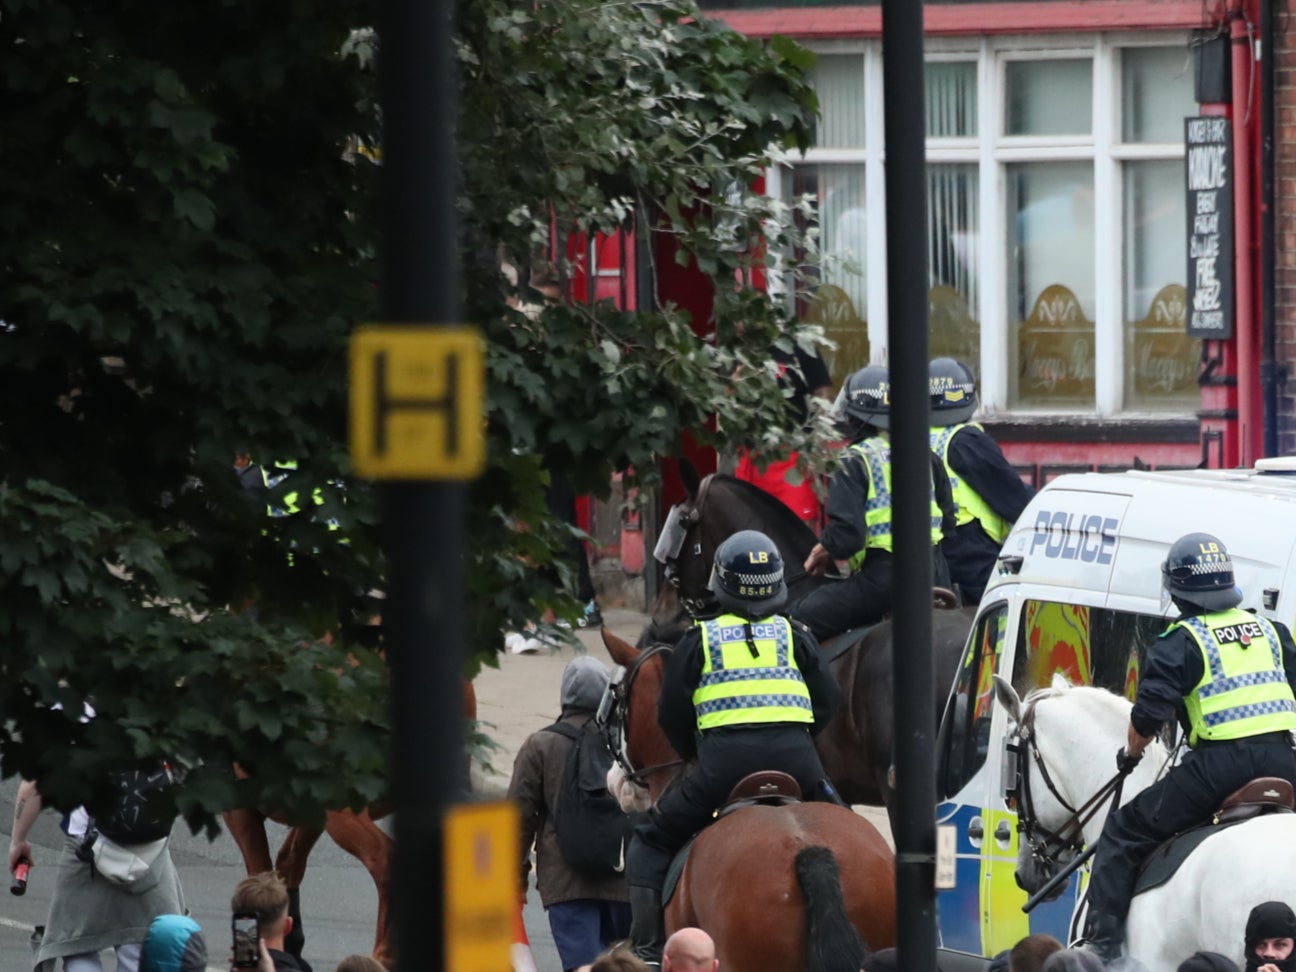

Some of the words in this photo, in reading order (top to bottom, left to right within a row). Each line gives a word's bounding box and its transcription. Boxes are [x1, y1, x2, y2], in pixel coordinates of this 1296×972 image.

[373, 351, 460, 458] H
[1029, 510, 1119, 565] POLICE
[1200, 542, 1220, 554] LB
[749, 551, 769, 564] LB
